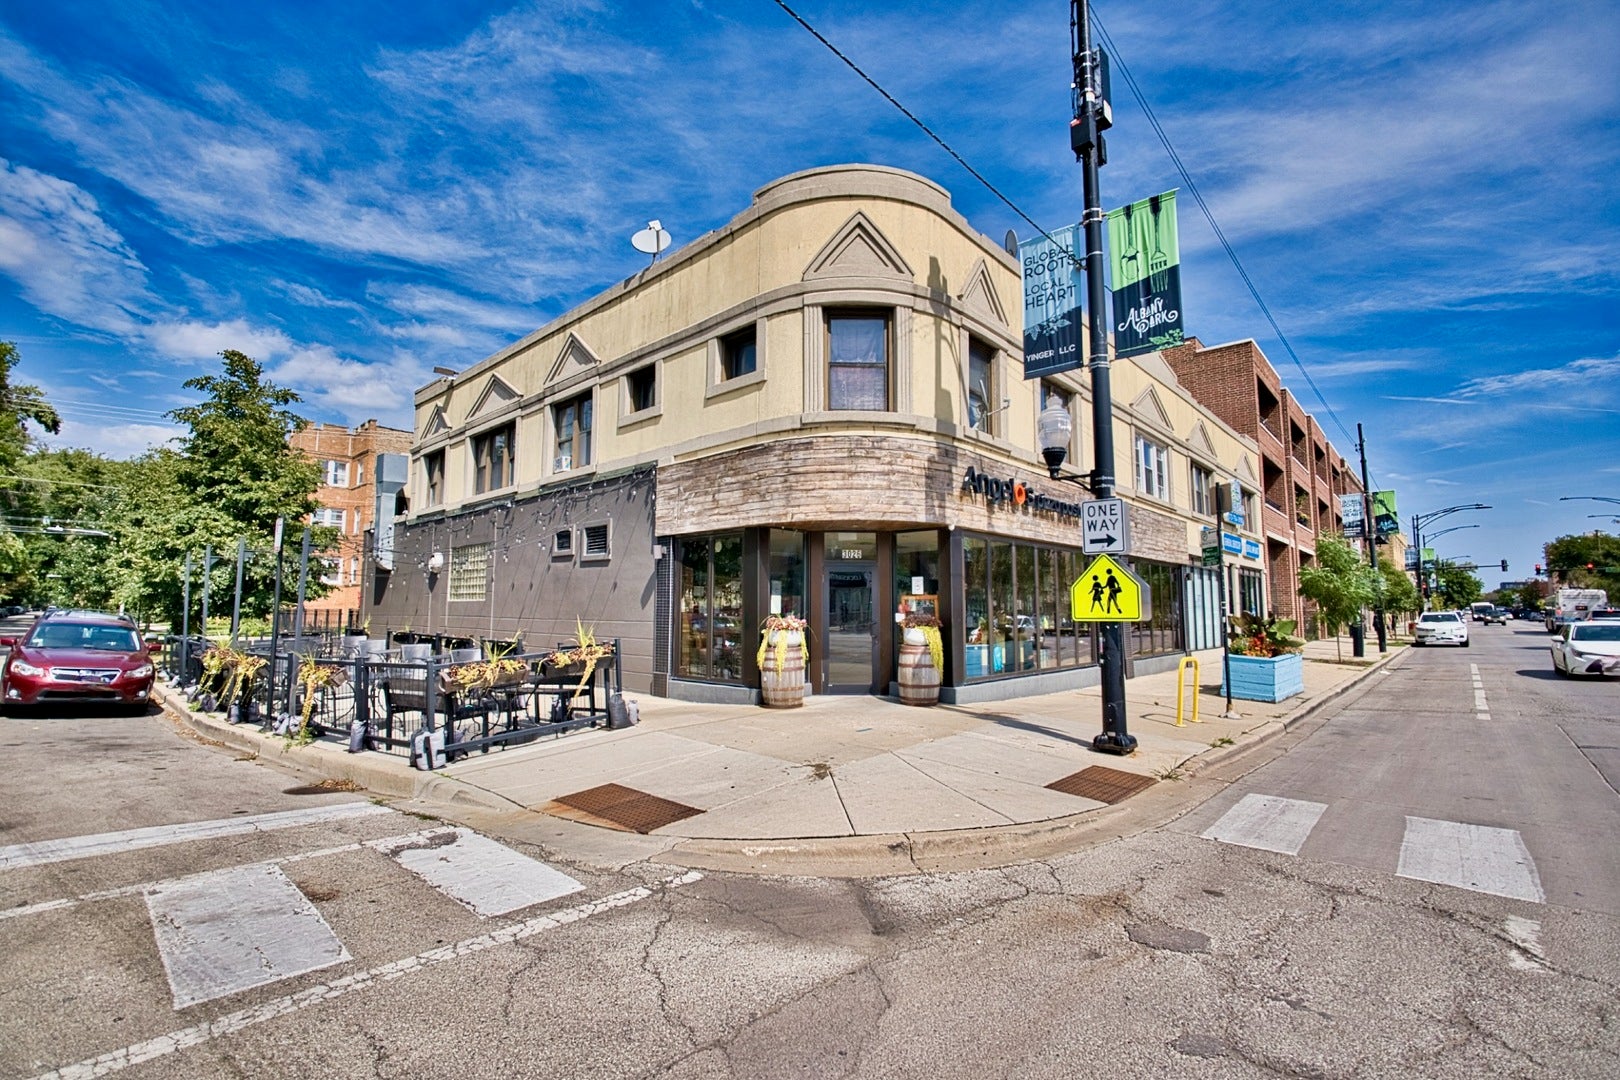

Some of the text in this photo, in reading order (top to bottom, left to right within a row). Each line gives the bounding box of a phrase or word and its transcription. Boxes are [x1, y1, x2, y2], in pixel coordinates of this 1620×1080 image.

[1024, 244, 1074, 266] GLOBAL
[1024, 254, 1077, 280] ROOTS
[1025, 277, 1065, 297] LOCAL
[1025, 285, 1077, 310] HEART
[1118, 297, 1164, 331] ALBANY
[1136, 310, 1178, 339] PARK
[1026, 344, 1076, 362] YINGER LLC
[1087, 504, 1118, 517] ONE
[1087, 518, 1118, 532] WAY
